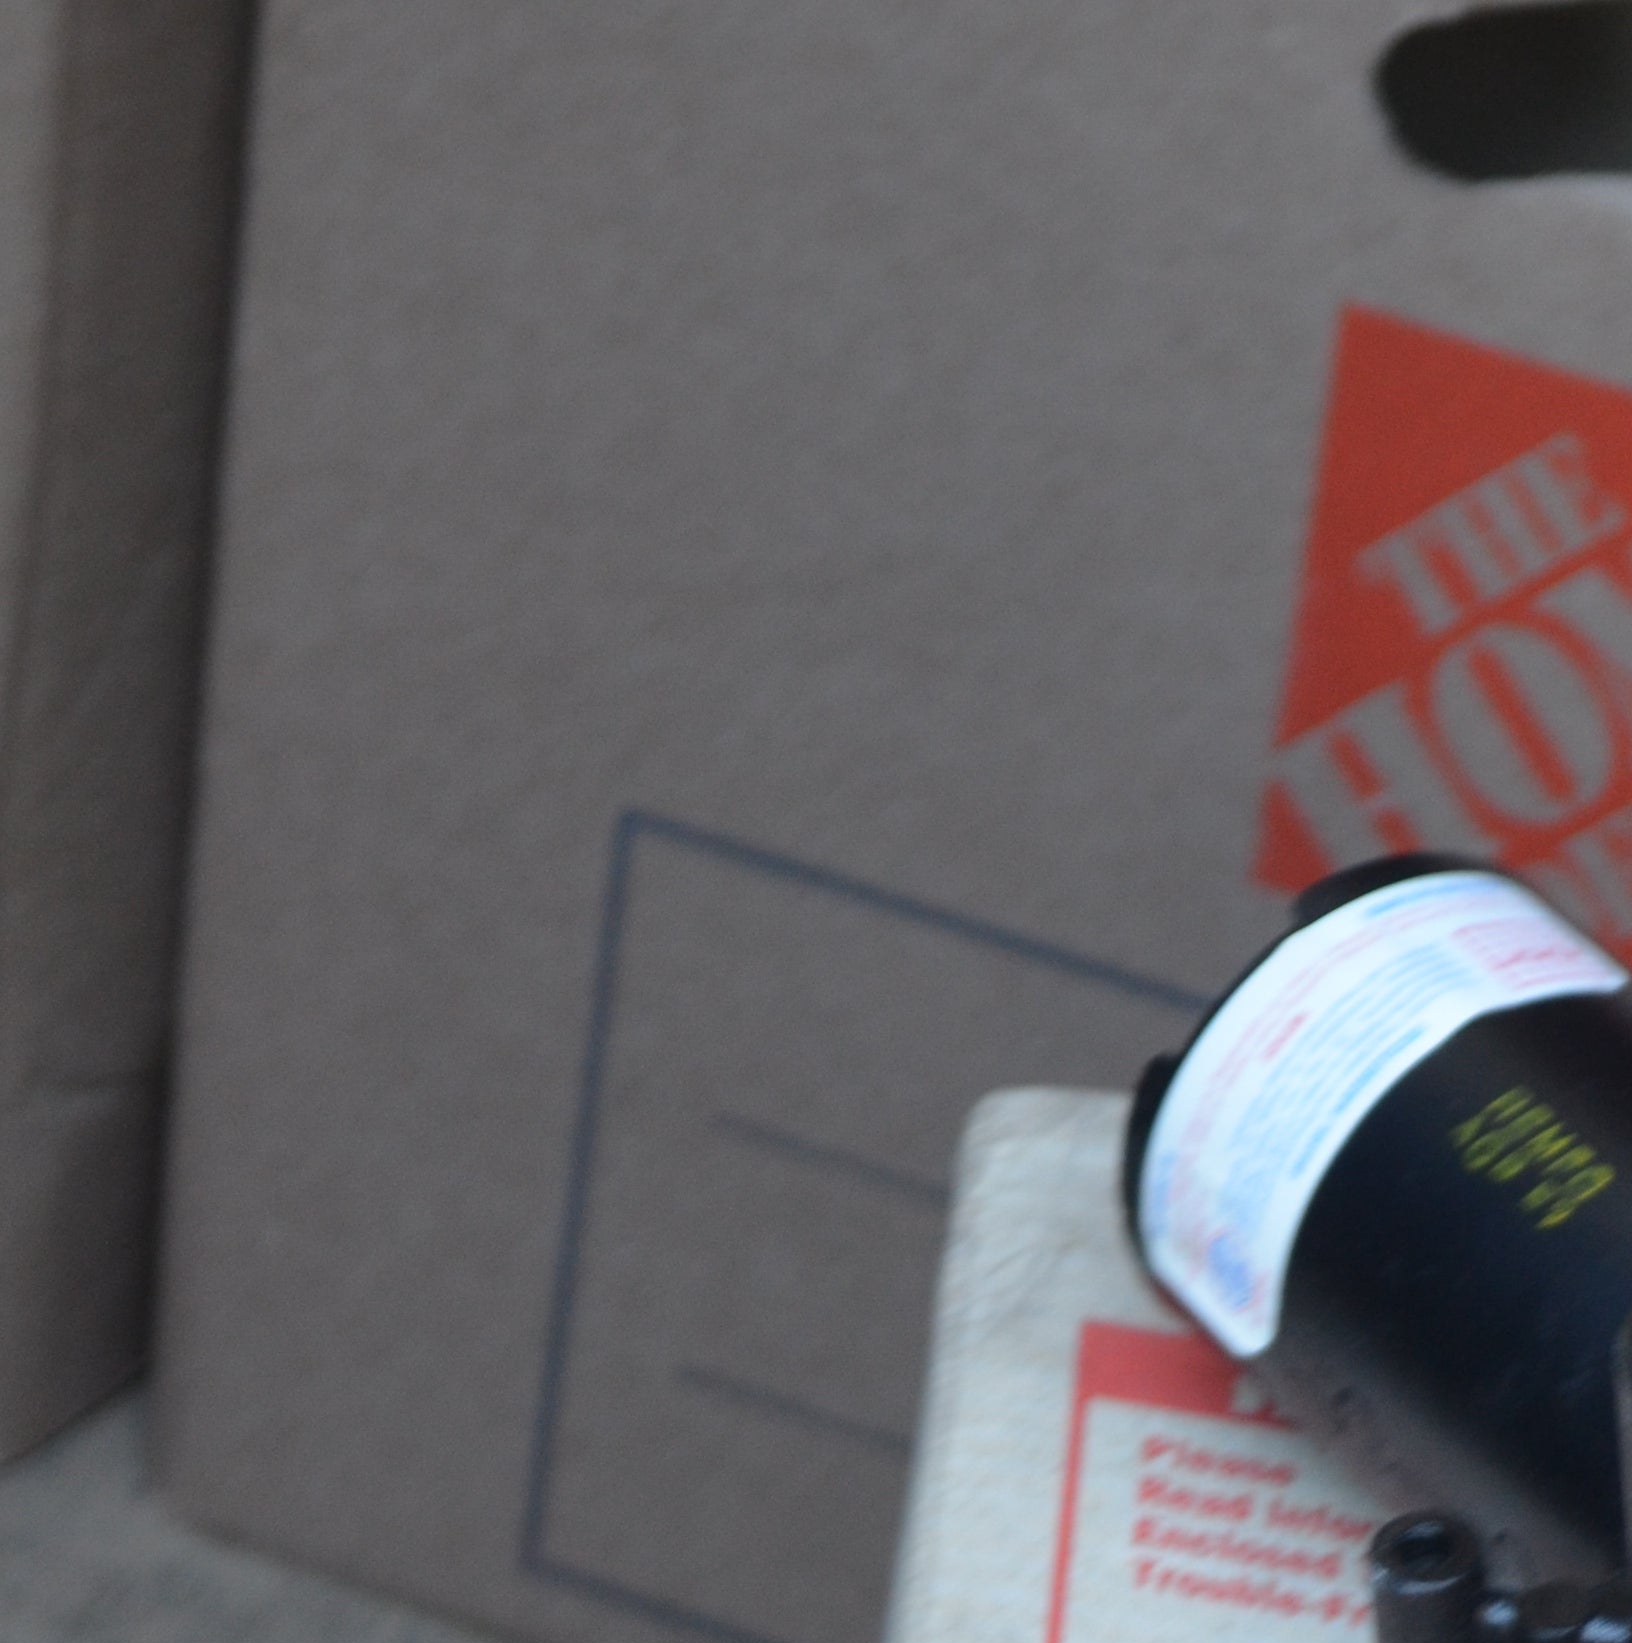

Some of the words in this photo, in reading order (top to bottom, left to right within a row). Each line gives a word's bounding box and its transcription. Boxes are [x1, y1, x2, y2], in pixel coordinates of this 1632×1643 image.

[1352, 430, 1632, 632] THE
[1138, 1434, 1296, 1487] Please
[1137, 1477, 1254, 1522] Read
[1132, 1518, 1343, 1578] Enclosed
